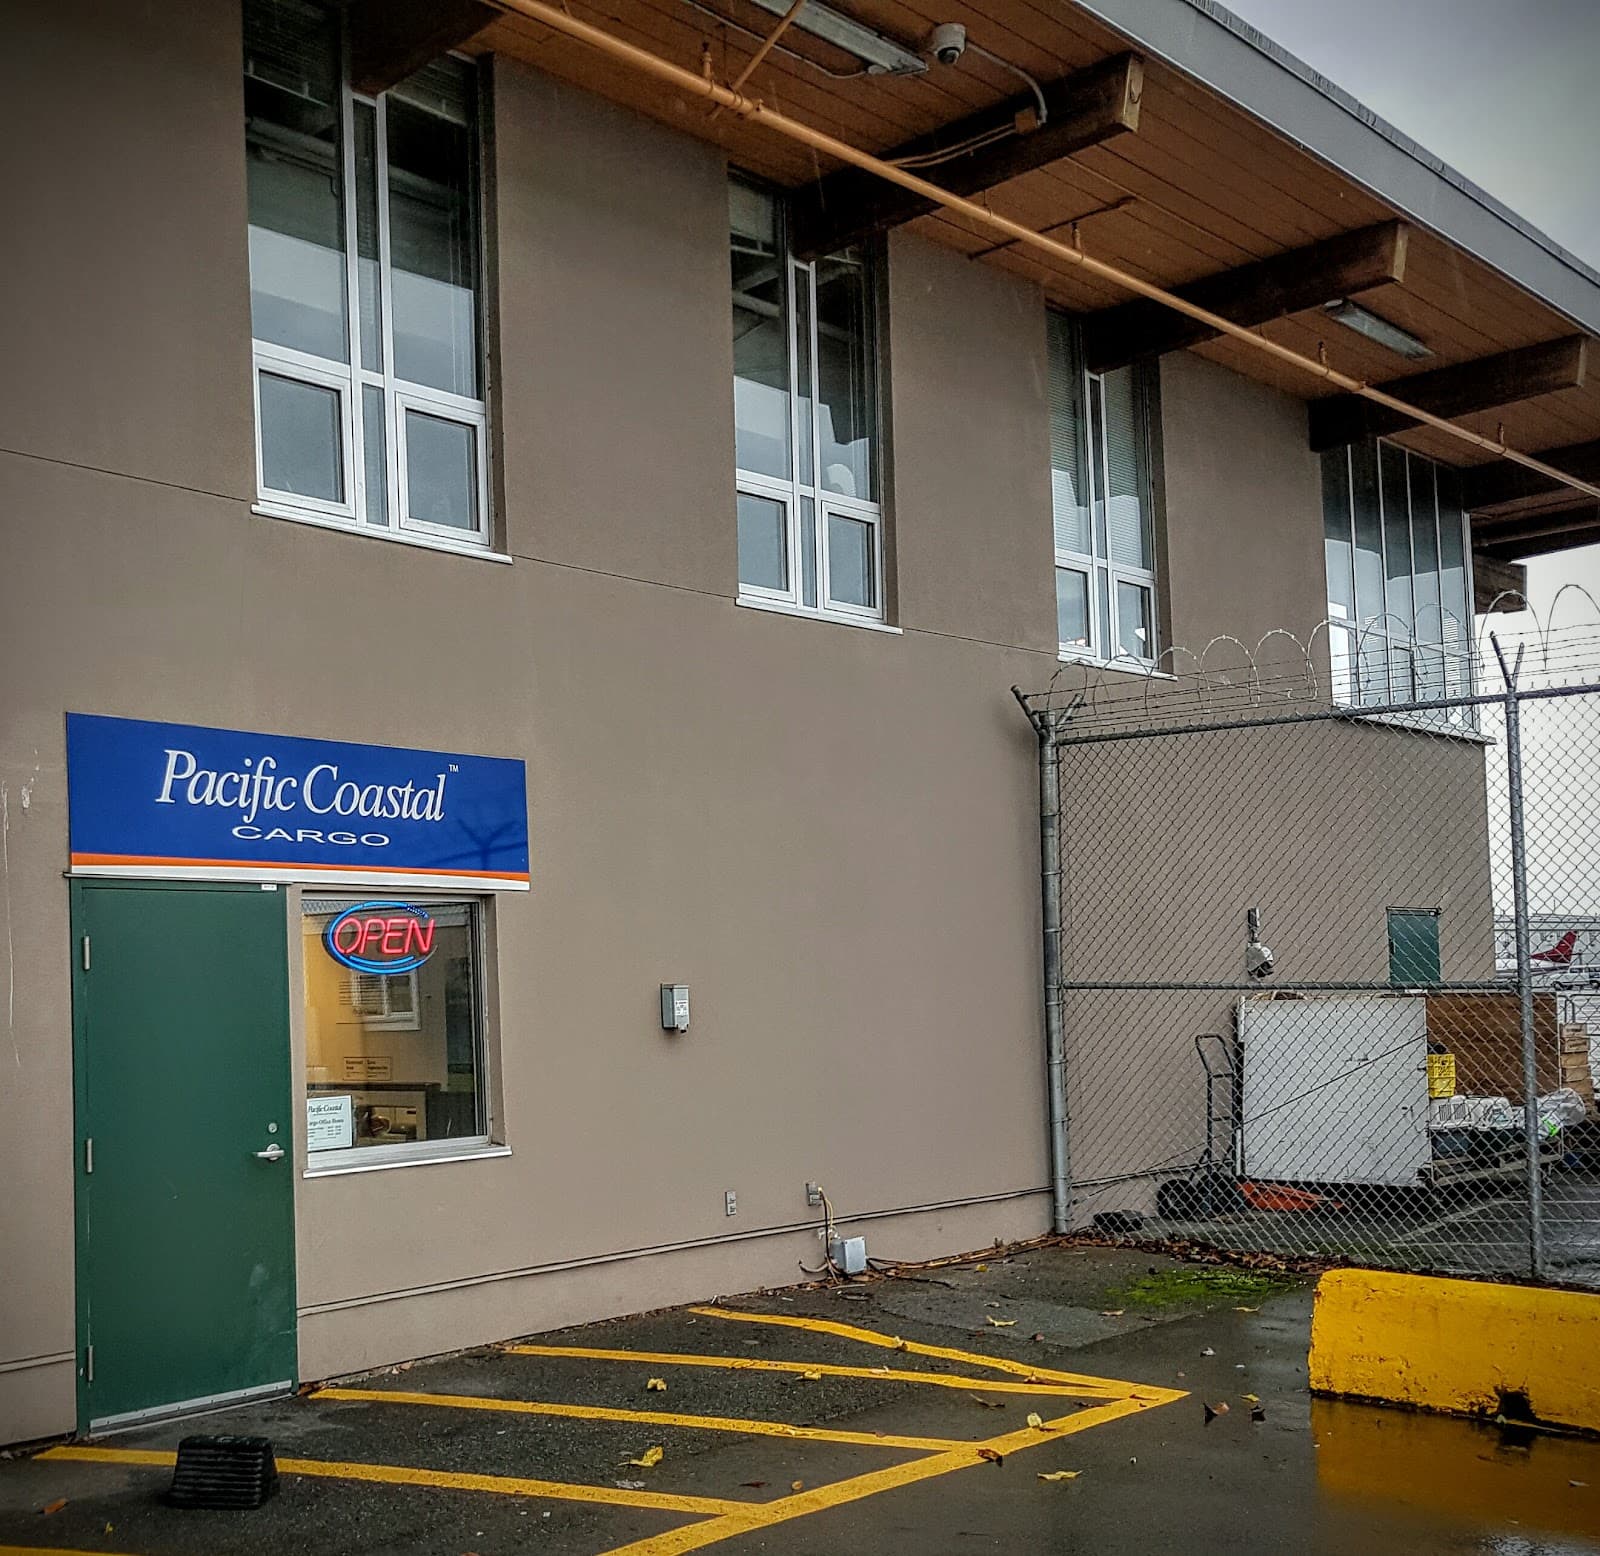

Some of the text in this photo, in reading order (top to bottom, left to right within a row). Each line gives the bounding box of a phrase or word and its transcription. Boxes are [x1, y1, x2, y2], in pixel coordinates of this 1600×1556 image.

[155, 749, 298, 823] Pacific
[302, 764, 446, 822] Coastal
[231, 825, 390, 846] CARGO
[334, 916, 436, 955] OPEN
